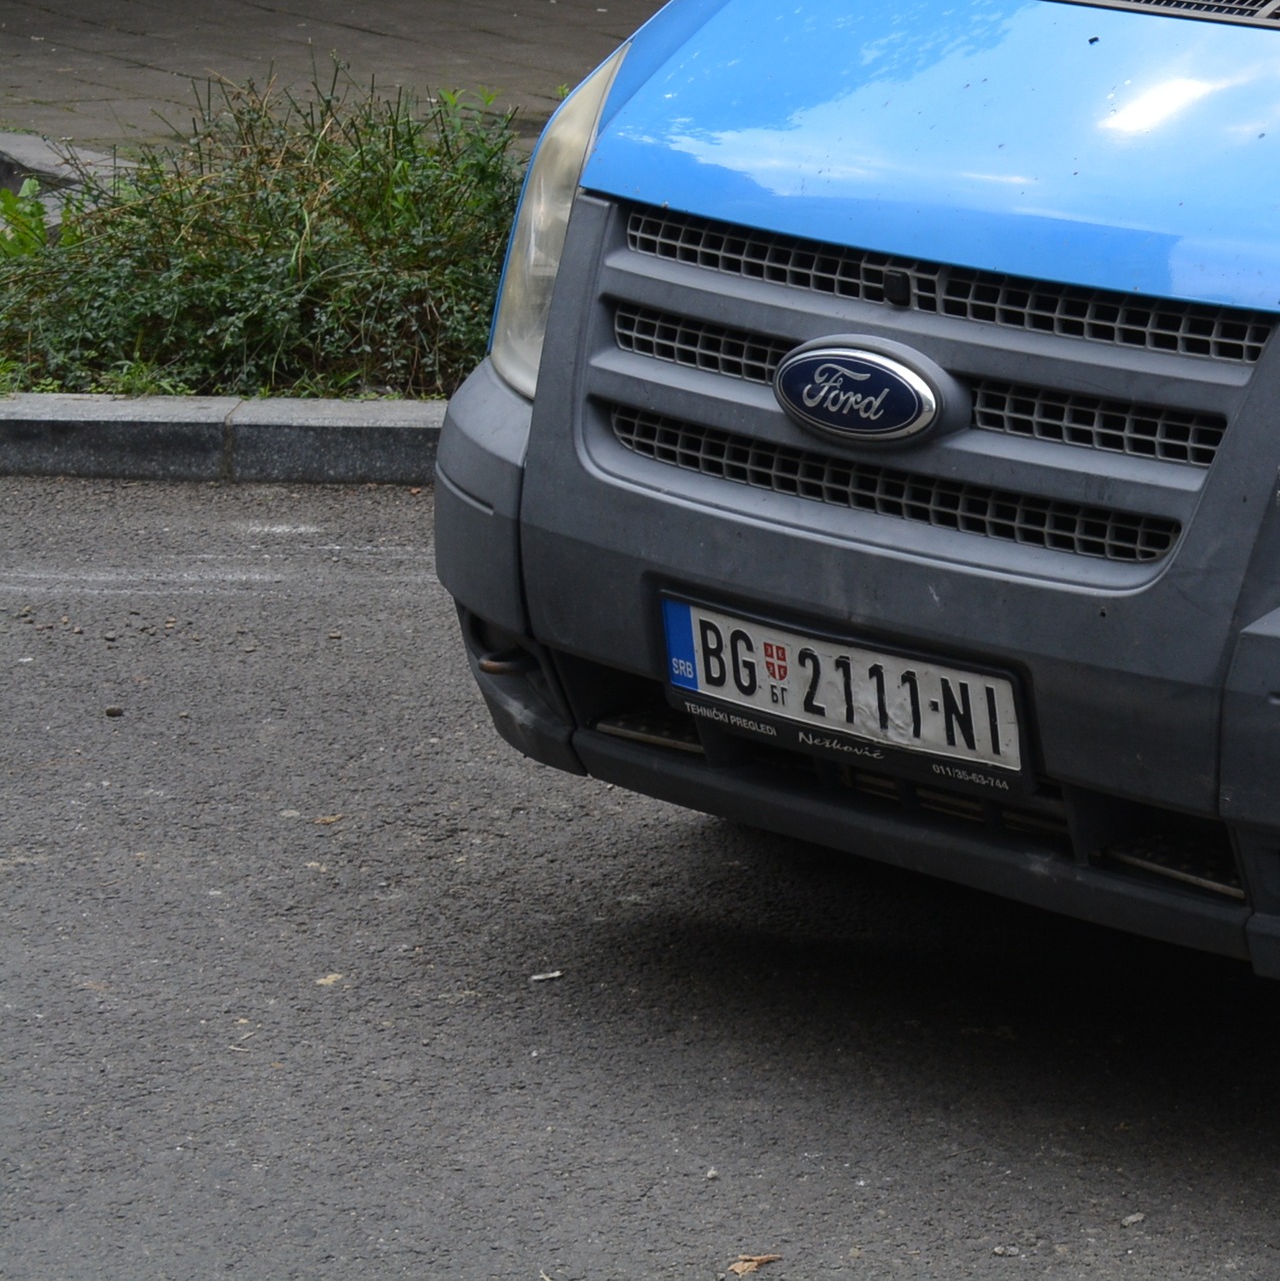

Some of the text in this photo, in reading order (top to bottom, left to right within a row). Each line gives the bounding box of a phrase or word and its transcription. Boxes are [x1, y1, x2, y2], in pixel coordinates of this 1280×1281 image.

[802, 363, 890, 421] Ford
[671, 656, 694, 679] SRB
[699, 617, 758, 697] BG
[729, 715, 777, 737] PREGLEDI
